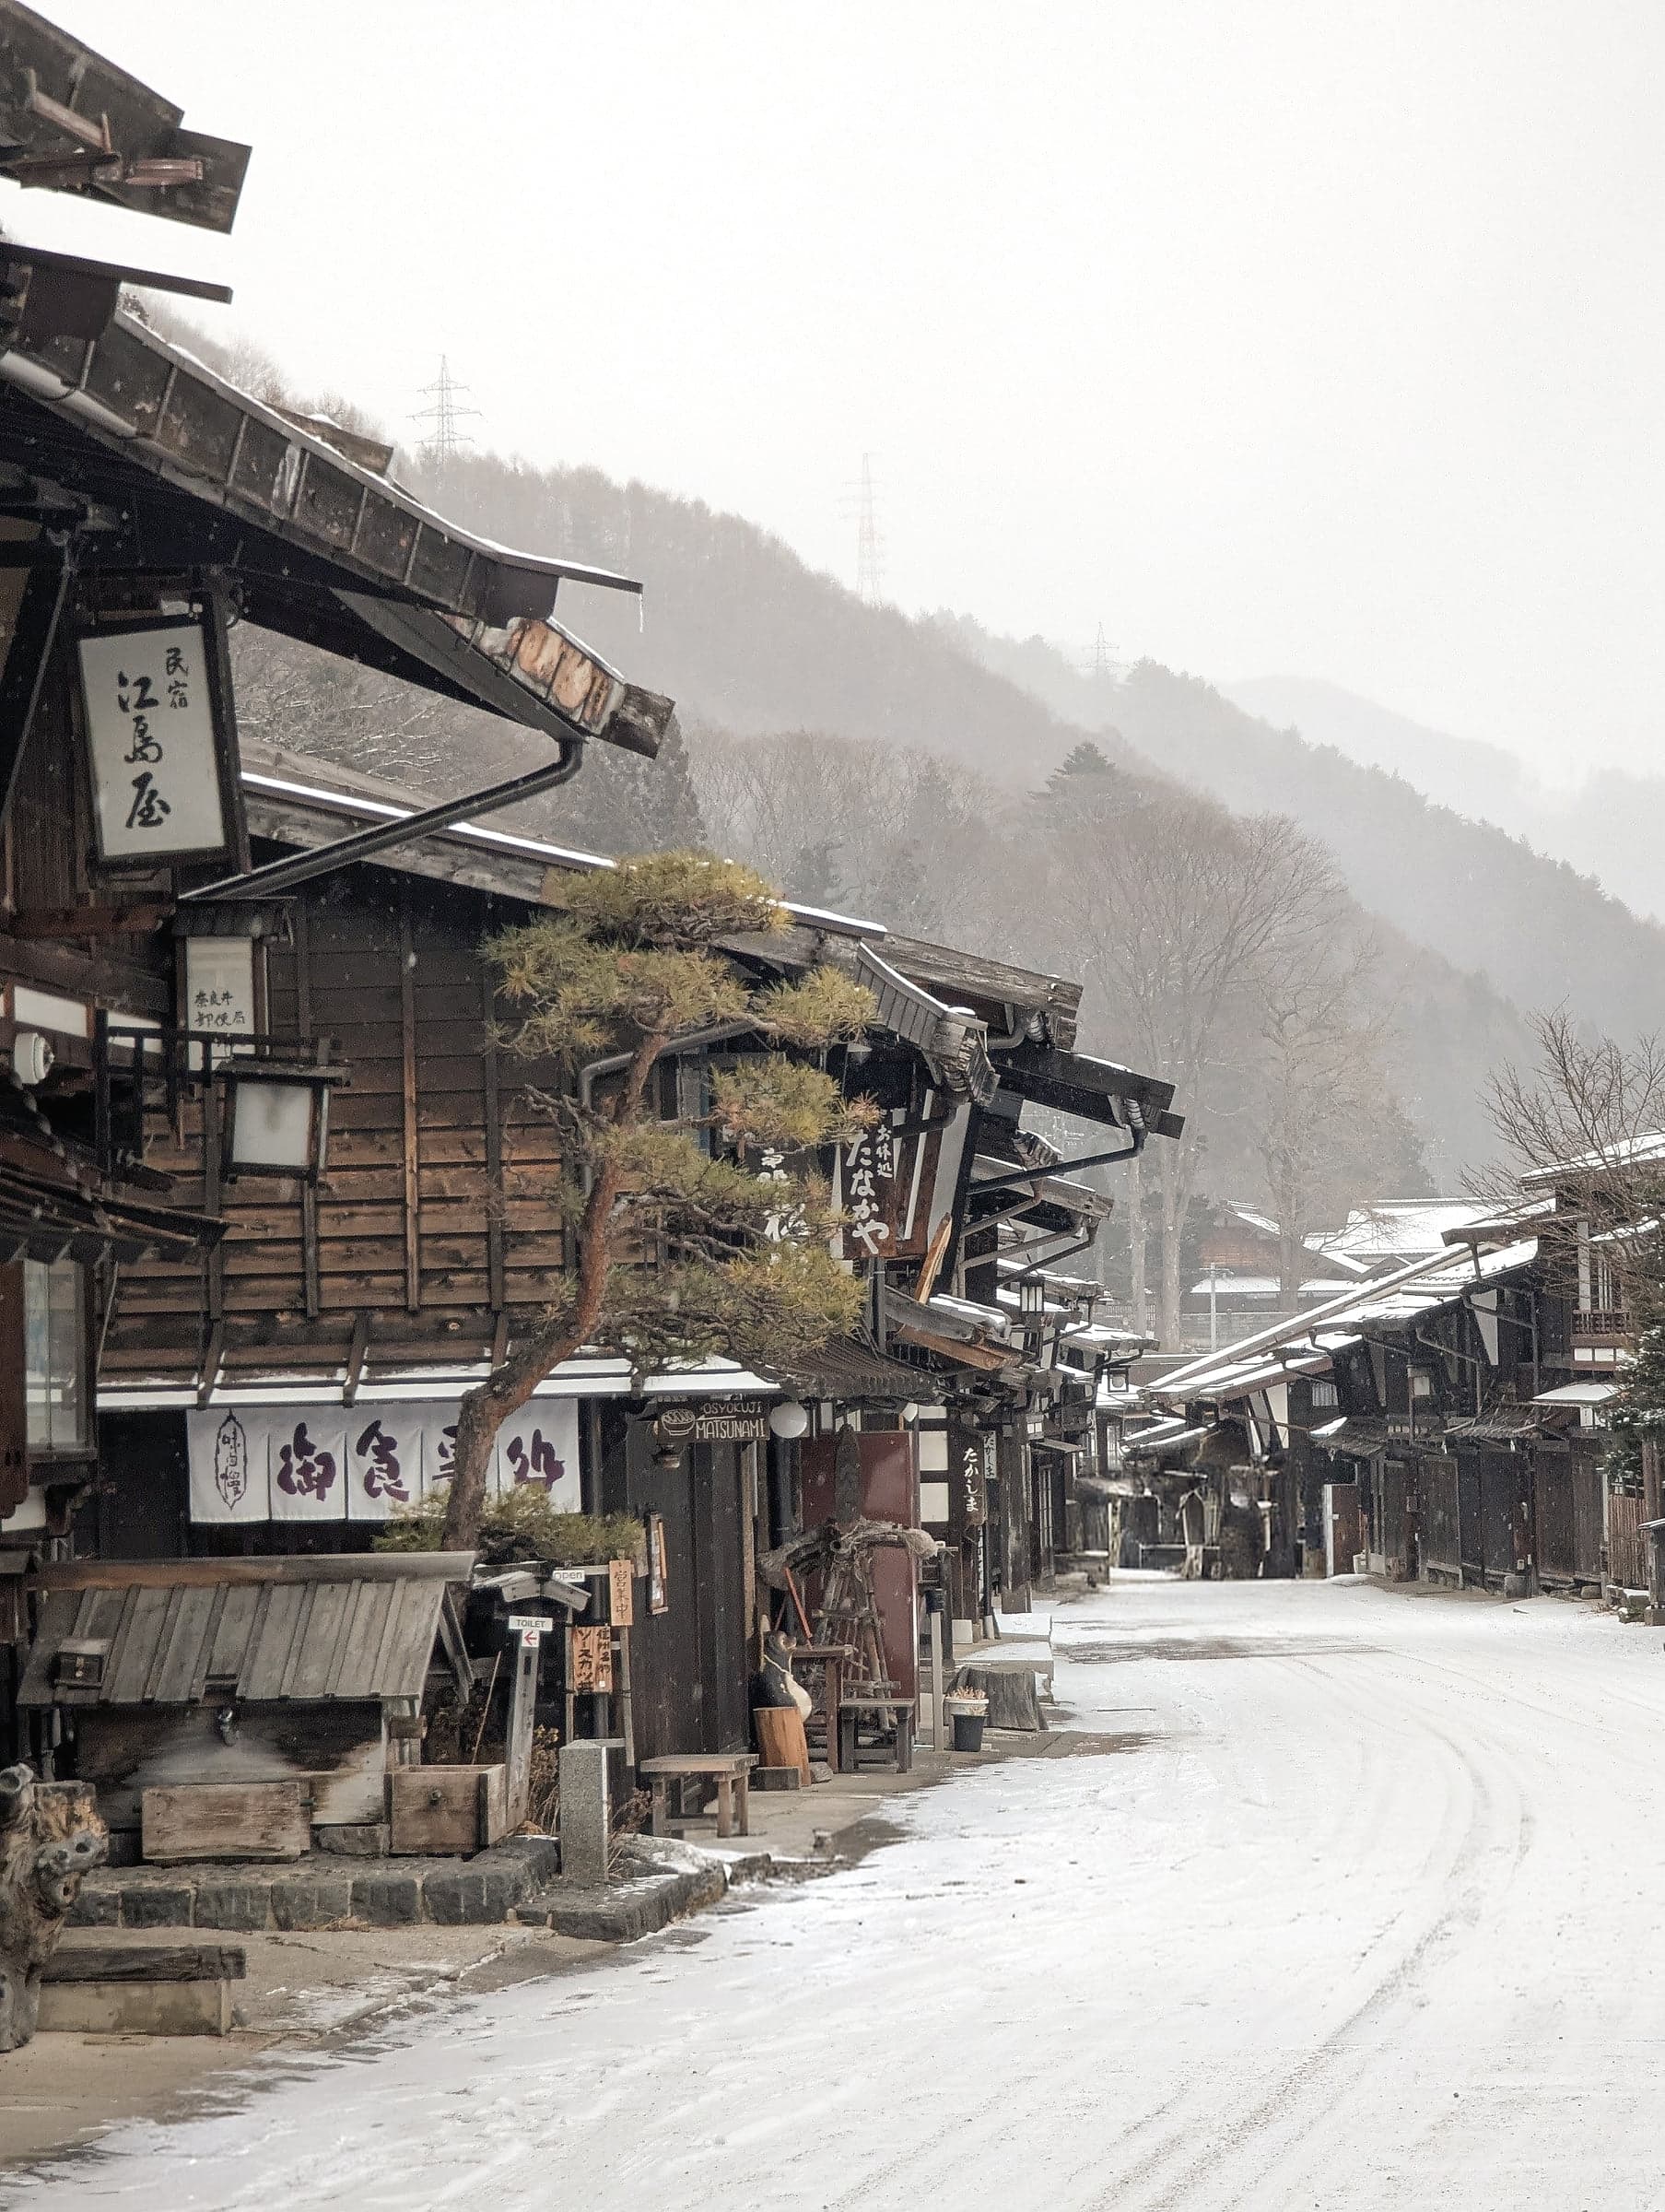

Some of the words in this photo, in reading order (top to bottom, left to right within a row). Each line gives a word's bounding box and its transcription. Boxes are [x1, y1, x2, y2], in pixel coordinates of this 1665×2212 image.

[166, 647, 189, 709] 民宿
[118, 671, 170, 829] 江島屋
[194, 990, 233, 1007] 奈良井
[194, 1011, 245, 1028] 郵便局
[846, 1129, 889, 1254] たなかや
[697, 1418, 766, 1440] MATSUNAMI
[963, 1447, 979, 1512] たかしま
[554, 1571, 582, 1582] open
[615, 1570, 630, 1619] 営業中
[517, 1619, 546, 1628] TOILET
